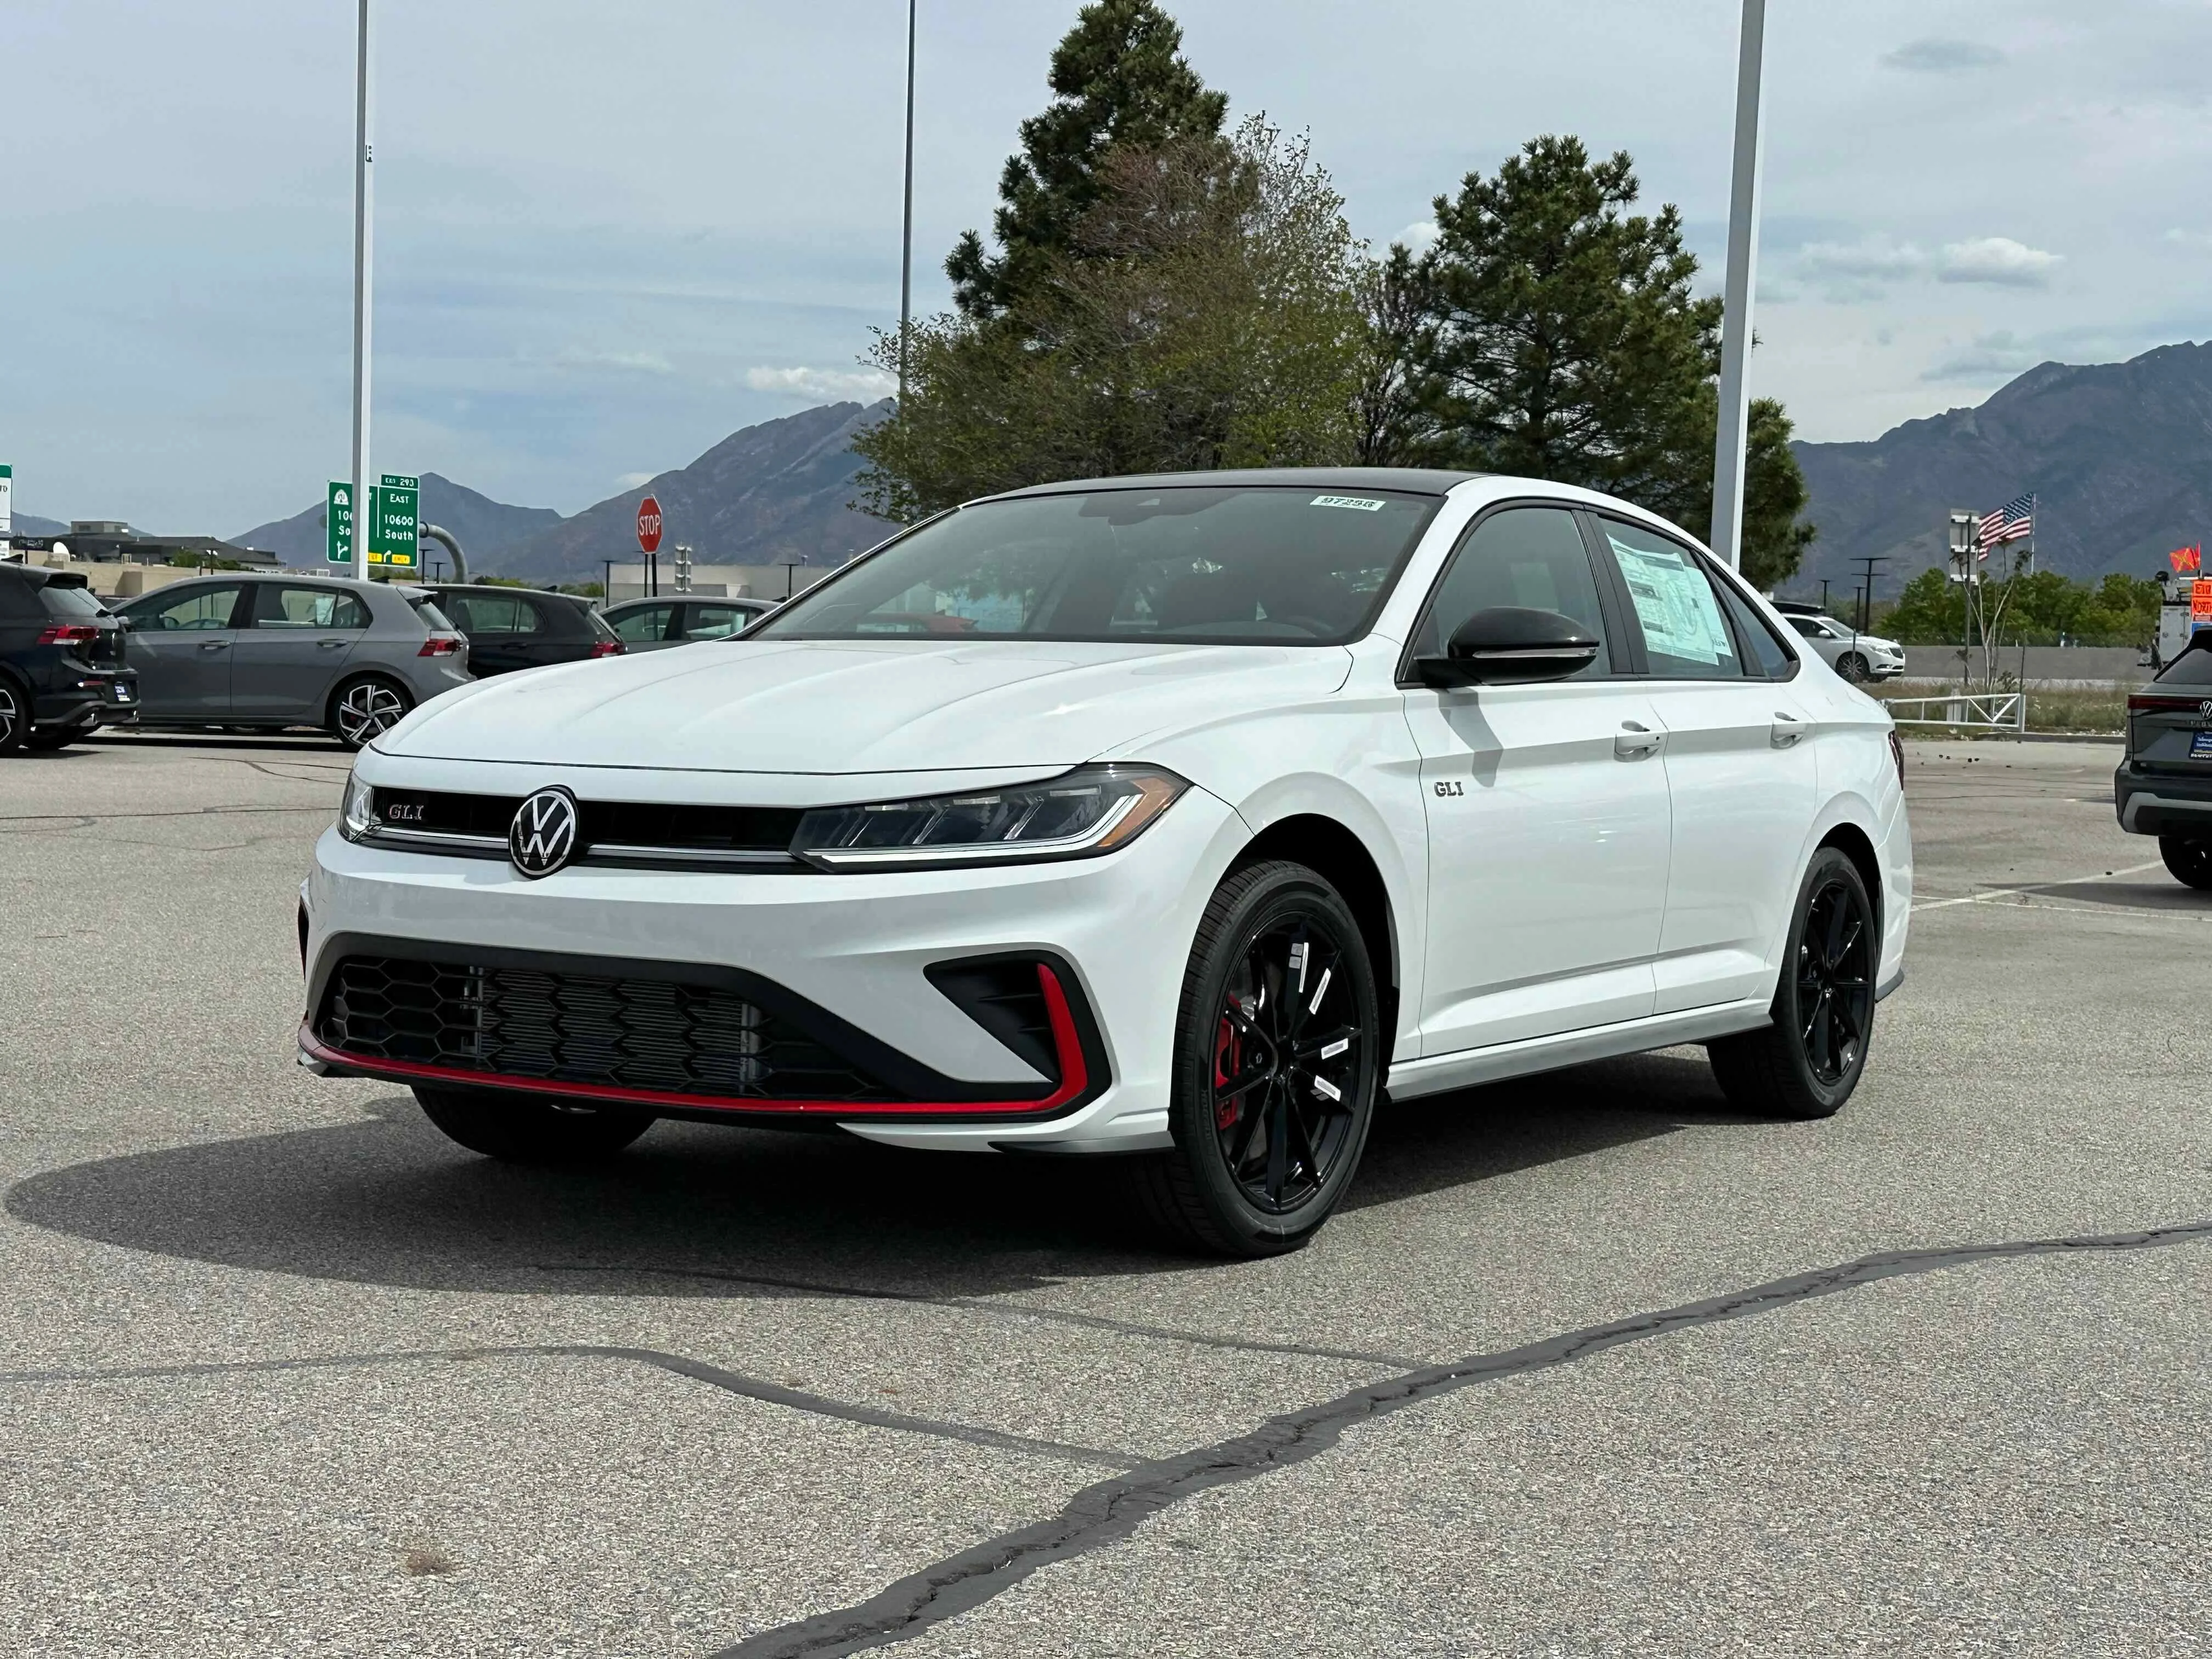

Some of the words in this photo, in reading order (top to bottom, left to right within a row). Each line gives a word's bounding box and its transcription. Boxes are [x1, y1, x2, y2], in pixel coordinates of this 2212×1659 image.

[390, 493, 409, 504] EAST
[385, 514, 414, 526] 10600
[639, 514, 661, 536] STOP
[385, 529, 413, 541] South
[1434, 781, 1464, 797] GLI
[389, 804, 424, 820] GLI
